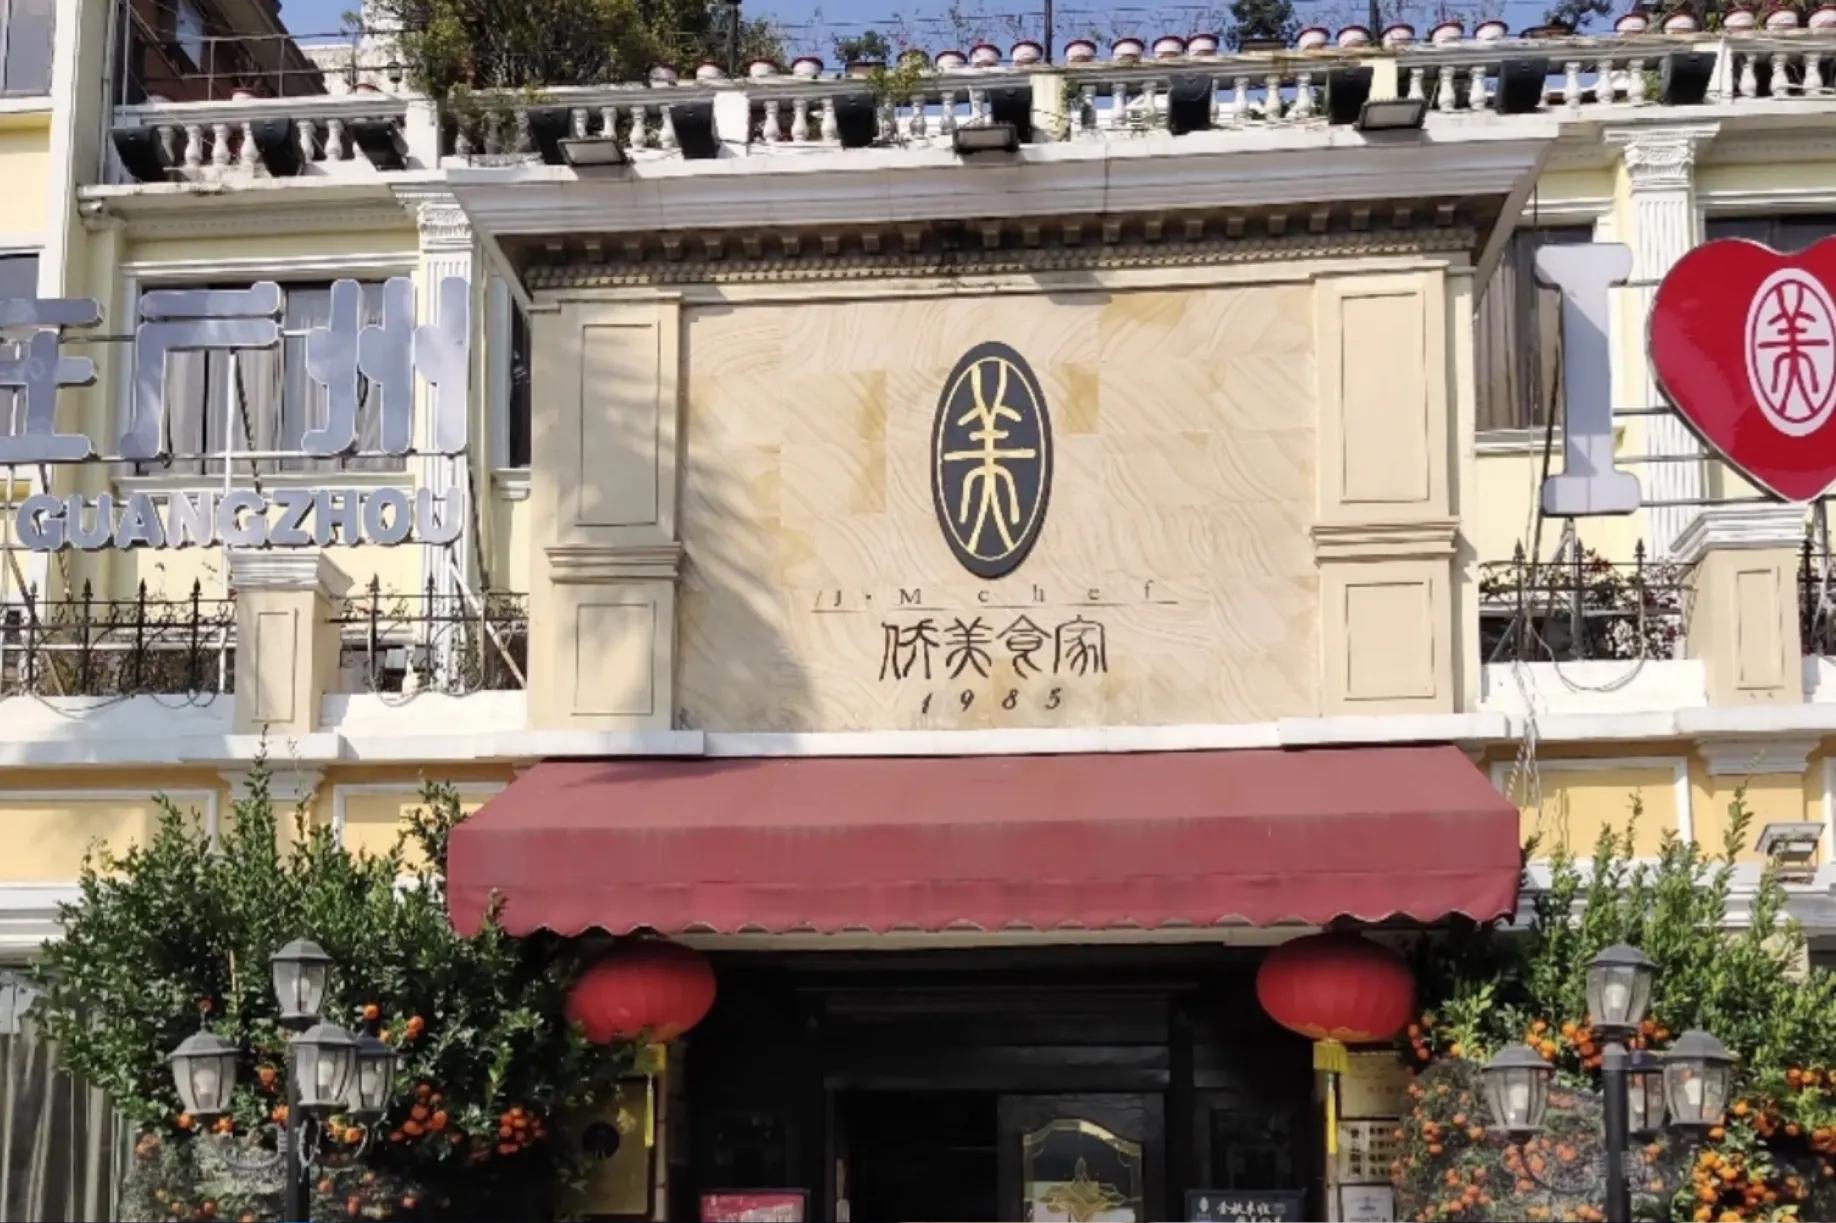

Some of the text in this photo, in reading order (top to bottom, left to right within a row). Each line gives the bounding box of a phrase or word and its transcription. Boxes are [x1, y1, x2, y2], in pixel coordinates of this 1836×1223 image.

[1535, 243, 1641, 515] I
[16, 487, 465, 550] GUANGZHOU
[879, 614, 1108, 682] 侨美食家
[921, 688, 1061, 714] 1985
